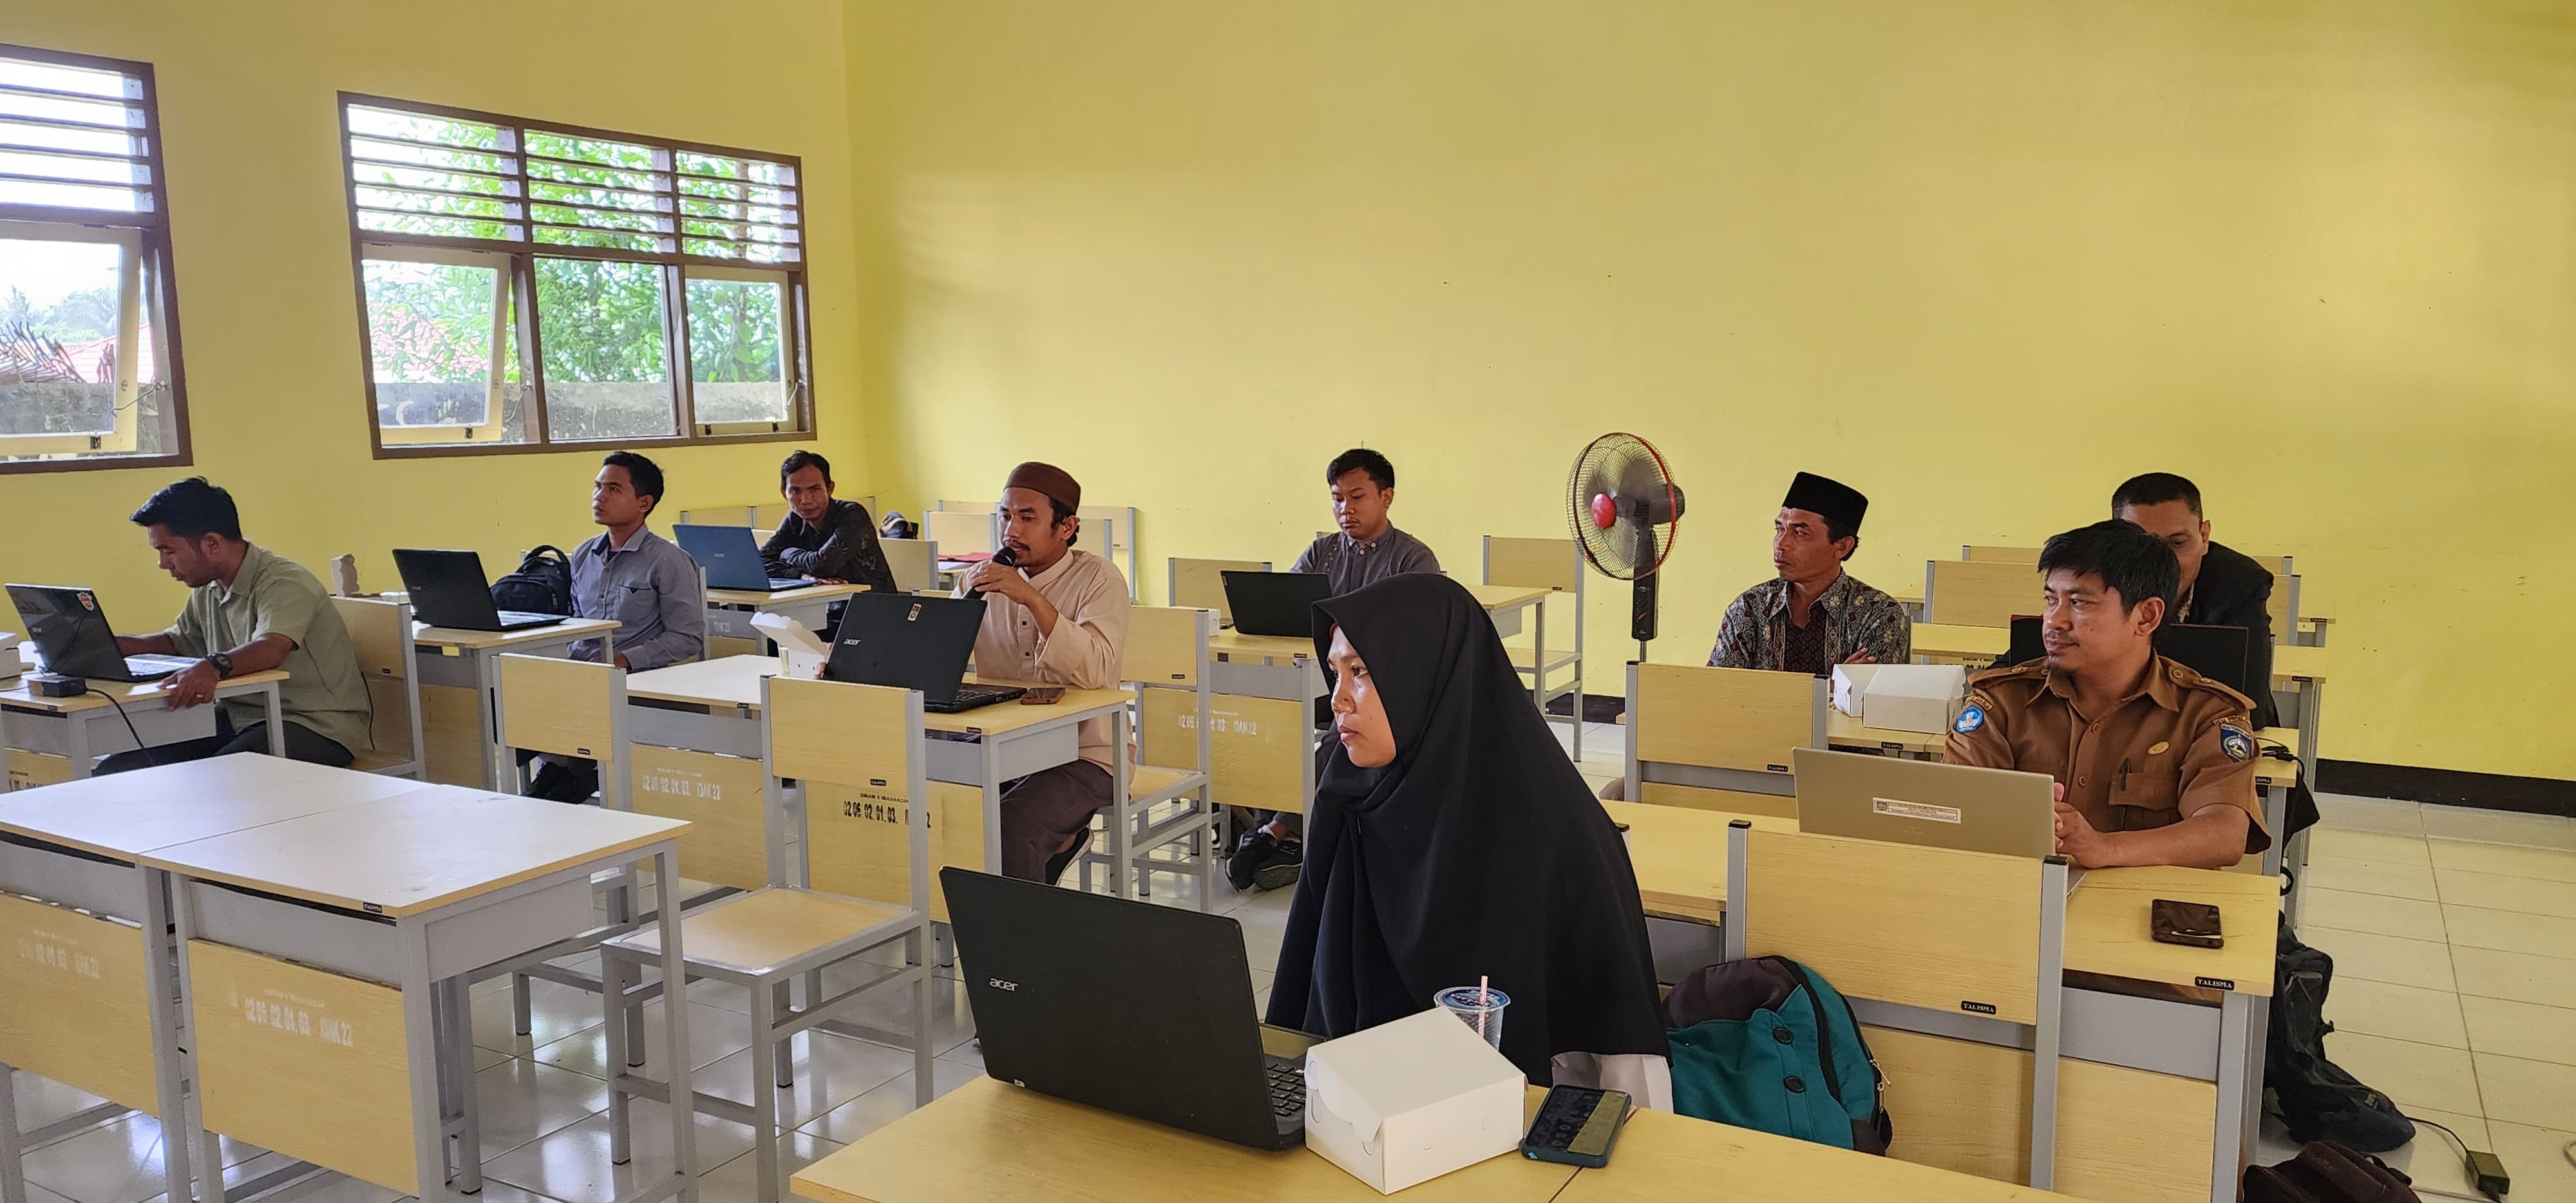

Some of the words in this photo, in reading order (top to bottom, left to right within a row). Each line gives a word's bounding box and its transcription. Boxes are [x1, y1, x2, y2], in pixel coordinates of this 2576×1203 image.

[989, 978, 1019, 992] acer
[2197, 978, 2233, 989] TALISMA
[1962, 1003, 1994, 1012] TALISMA
